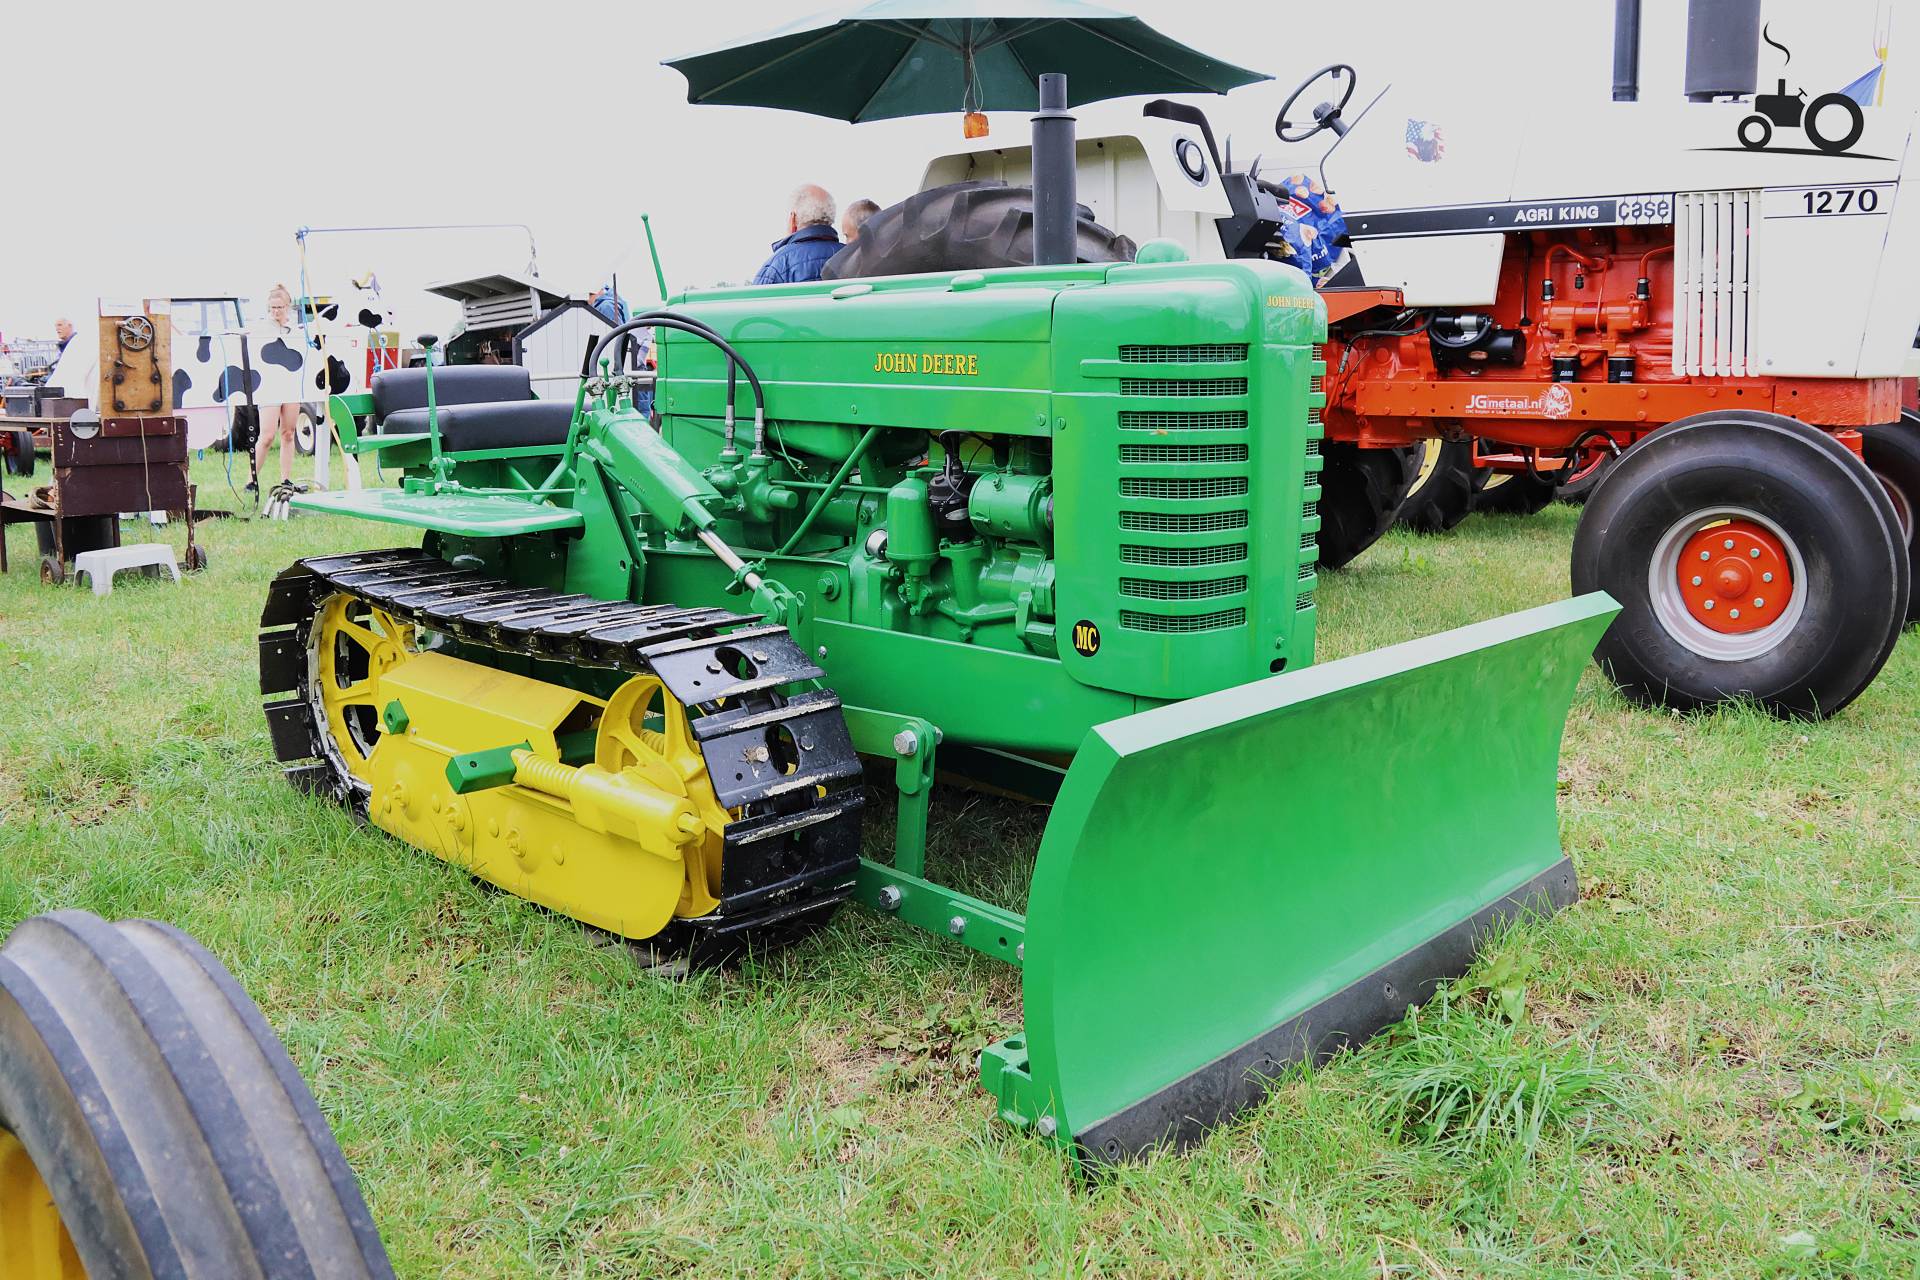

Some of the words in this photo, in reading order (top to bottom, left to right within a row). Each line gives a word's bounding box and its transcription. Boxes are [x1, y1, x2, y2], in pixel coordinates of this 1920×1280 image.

[1803, 189, 1878, 214] 1270
[1514, 208, 1553, 222] AGRI
[1559, 206, 1599, 220] KING
[1265, 295, 1291, 308] JOHN
[874, 353, 917, 373] JOHN
[921, 353, 978, 376] DEERE
[1465, 394, 1542, 409] JGmetaal.nl
[1076, 625, 1097, 652] MC
